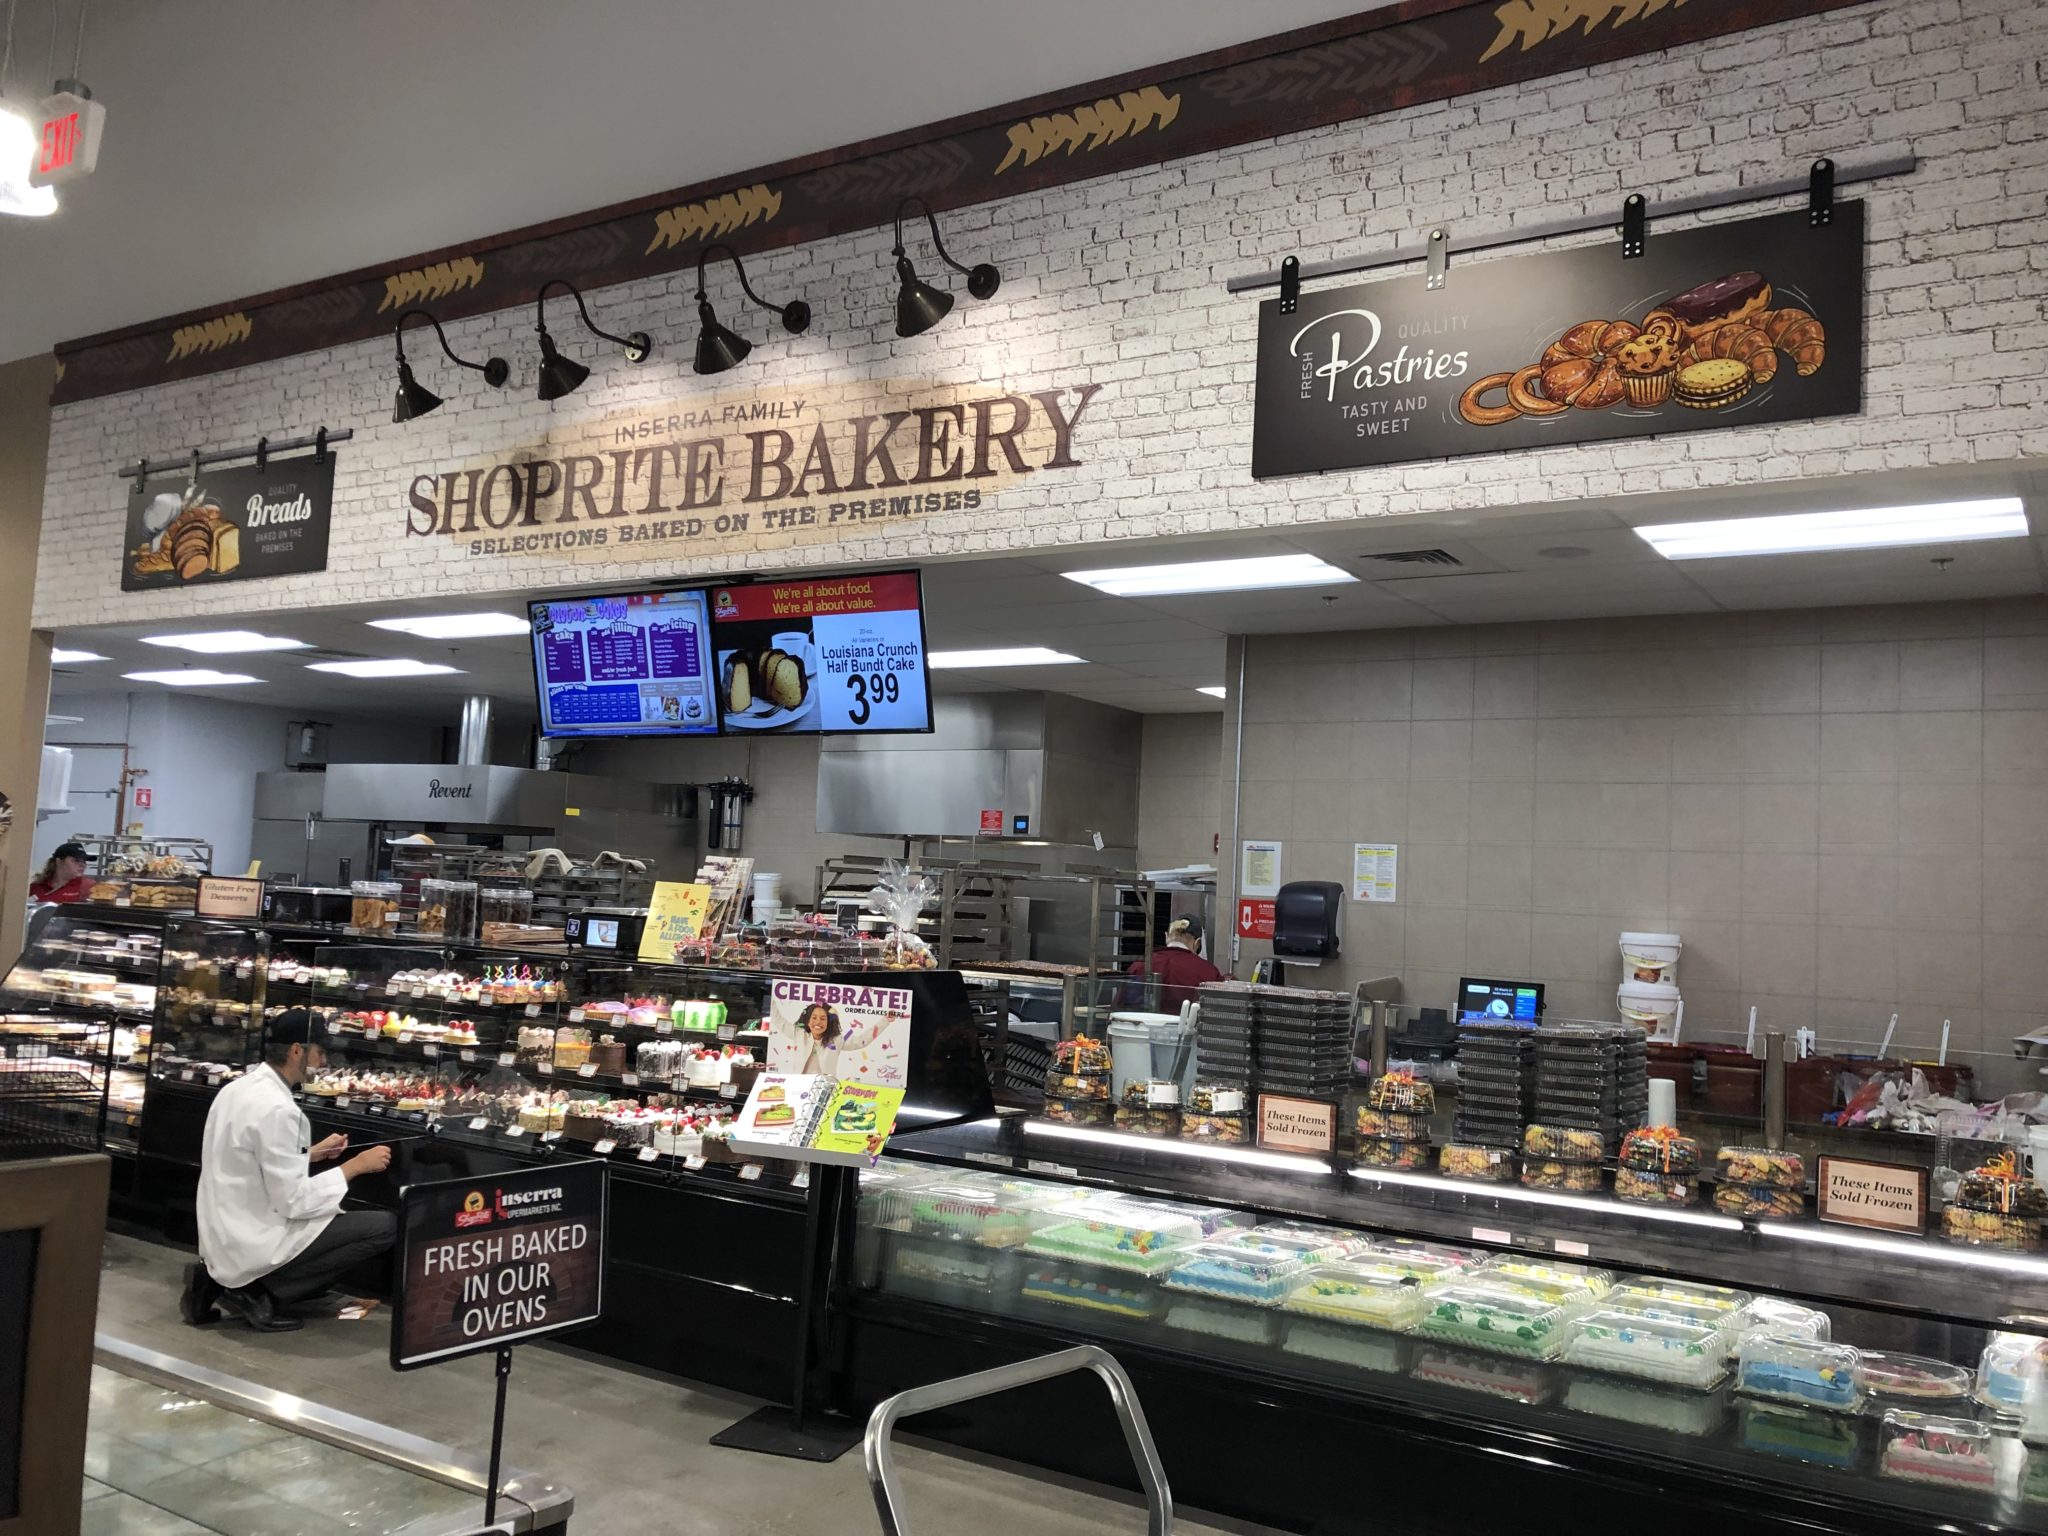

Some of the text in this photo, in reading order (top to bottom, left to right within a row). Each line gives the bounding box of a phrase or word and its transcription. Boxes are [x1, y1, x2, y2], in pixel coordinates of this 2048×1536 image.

[1398, 314, 1470, 339] QUALITY
[1290, 308, 1469, 402] Pastries
[1300, 351, 1313, 399] FRESH
[1341, 395, 1428, 418] TASTY AND
[614, 399, 807, 441] INSERRA FAMILY
[1356, 417, 1411, 437] SWEET
[405, 383, 1103, 537] SHOPRITE BAKERY
[246, 493, 312, 527] Breads
[289, 528, 303, 538] THE
[470, 489, 982, 556] SELECTIONS BAKED ON THE PREMISES
[772, 581, 873, 600] We're all about food.
[772, 596, 876, 615] We're all about value.
[822, 642, 918, 659] Louisiana Crunch
[827, 656, 915, 673] Half Bundt Cake
[429, 779, 472, 798] Revent
[774, 981, 908, 1010] CELEBRATE!
[1266, 1110, 1327, 1126] These Items
[1266, 1122, 1326, 1138] Sold Frozen
[1831, 1175, 1913, 1196] These Items
[495, 1187, 563, 1214] inserra
[1829, 1189, 1913, 1211] Sold Frozen
[424, 1224, 587, 1276] FRESH BAKED
[463, 1262, 550, 1303] IN OUR
[462, 1295, 547, 1337] OVENS
